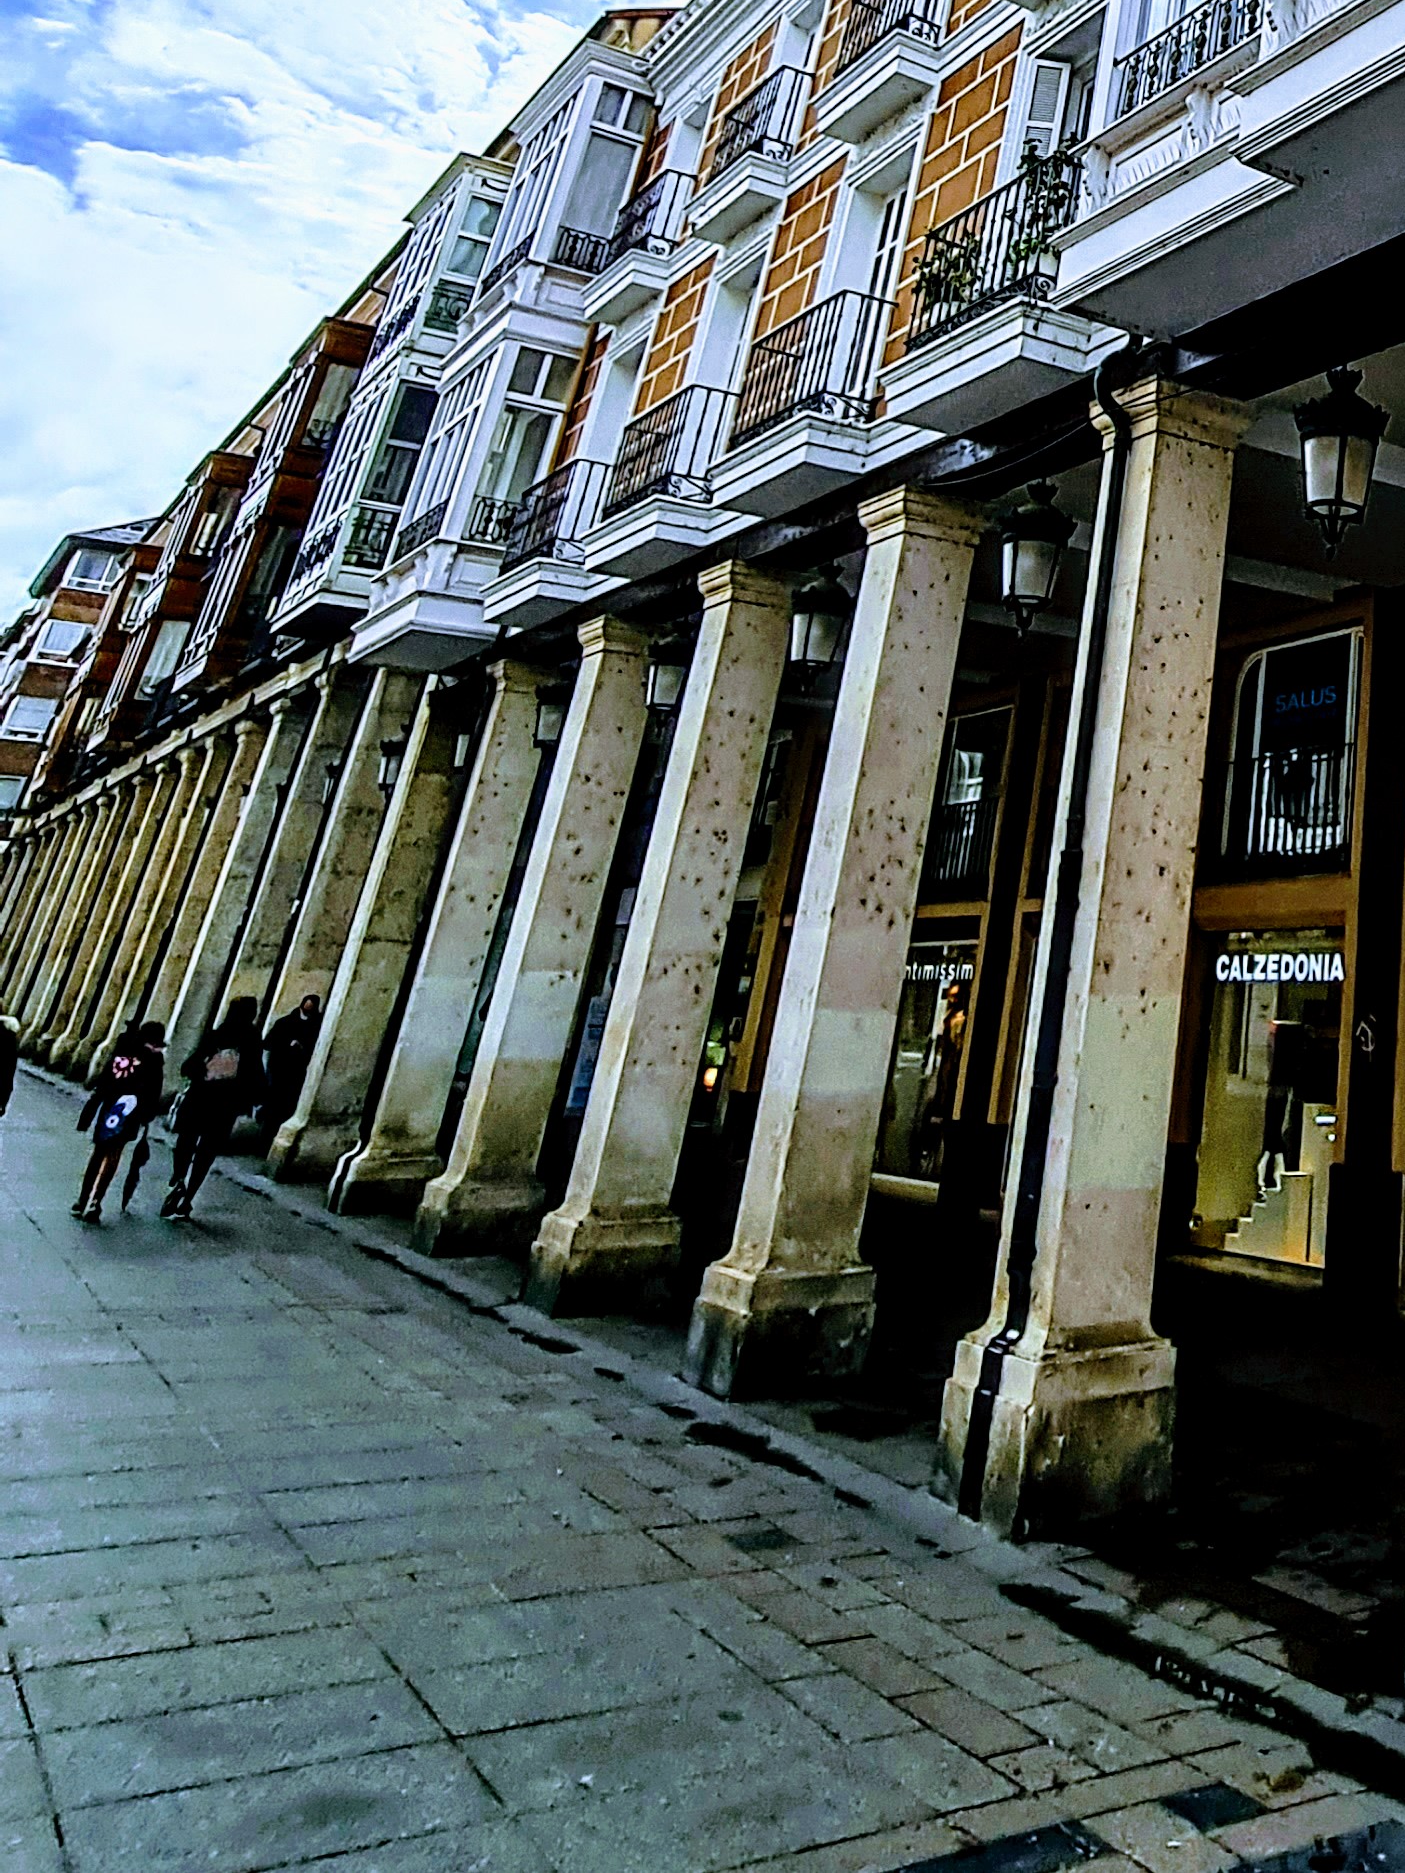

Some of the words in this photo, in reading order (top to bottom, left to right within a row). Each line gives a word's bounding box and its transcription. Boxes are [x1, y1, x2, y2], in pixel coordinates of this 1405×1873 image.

[1274, 685, 1337, 714] SALUS
[905, 961, 974, 981] ntimissim
[1216, 953, 1345, 982] CALZEDONIA
